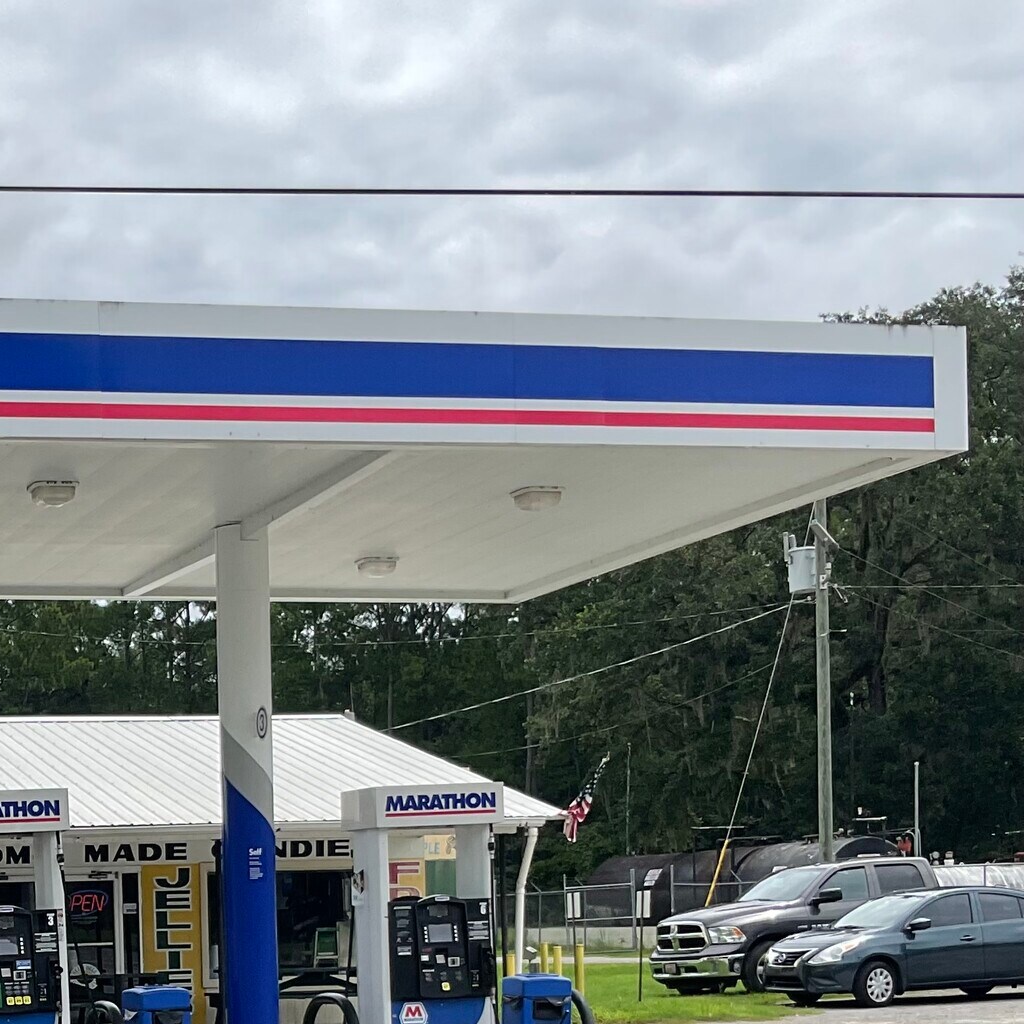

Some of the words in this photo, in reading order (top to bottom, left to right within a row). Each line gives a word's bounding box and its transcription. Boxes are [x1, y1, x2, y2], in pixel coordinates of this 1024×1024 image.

[385, 791, 496, 812] MARATHON
[84, 841, 188, 863] MADE
[69, 894, 105, 912] PEN
[155, 867, 193, 1013] JELLIE
